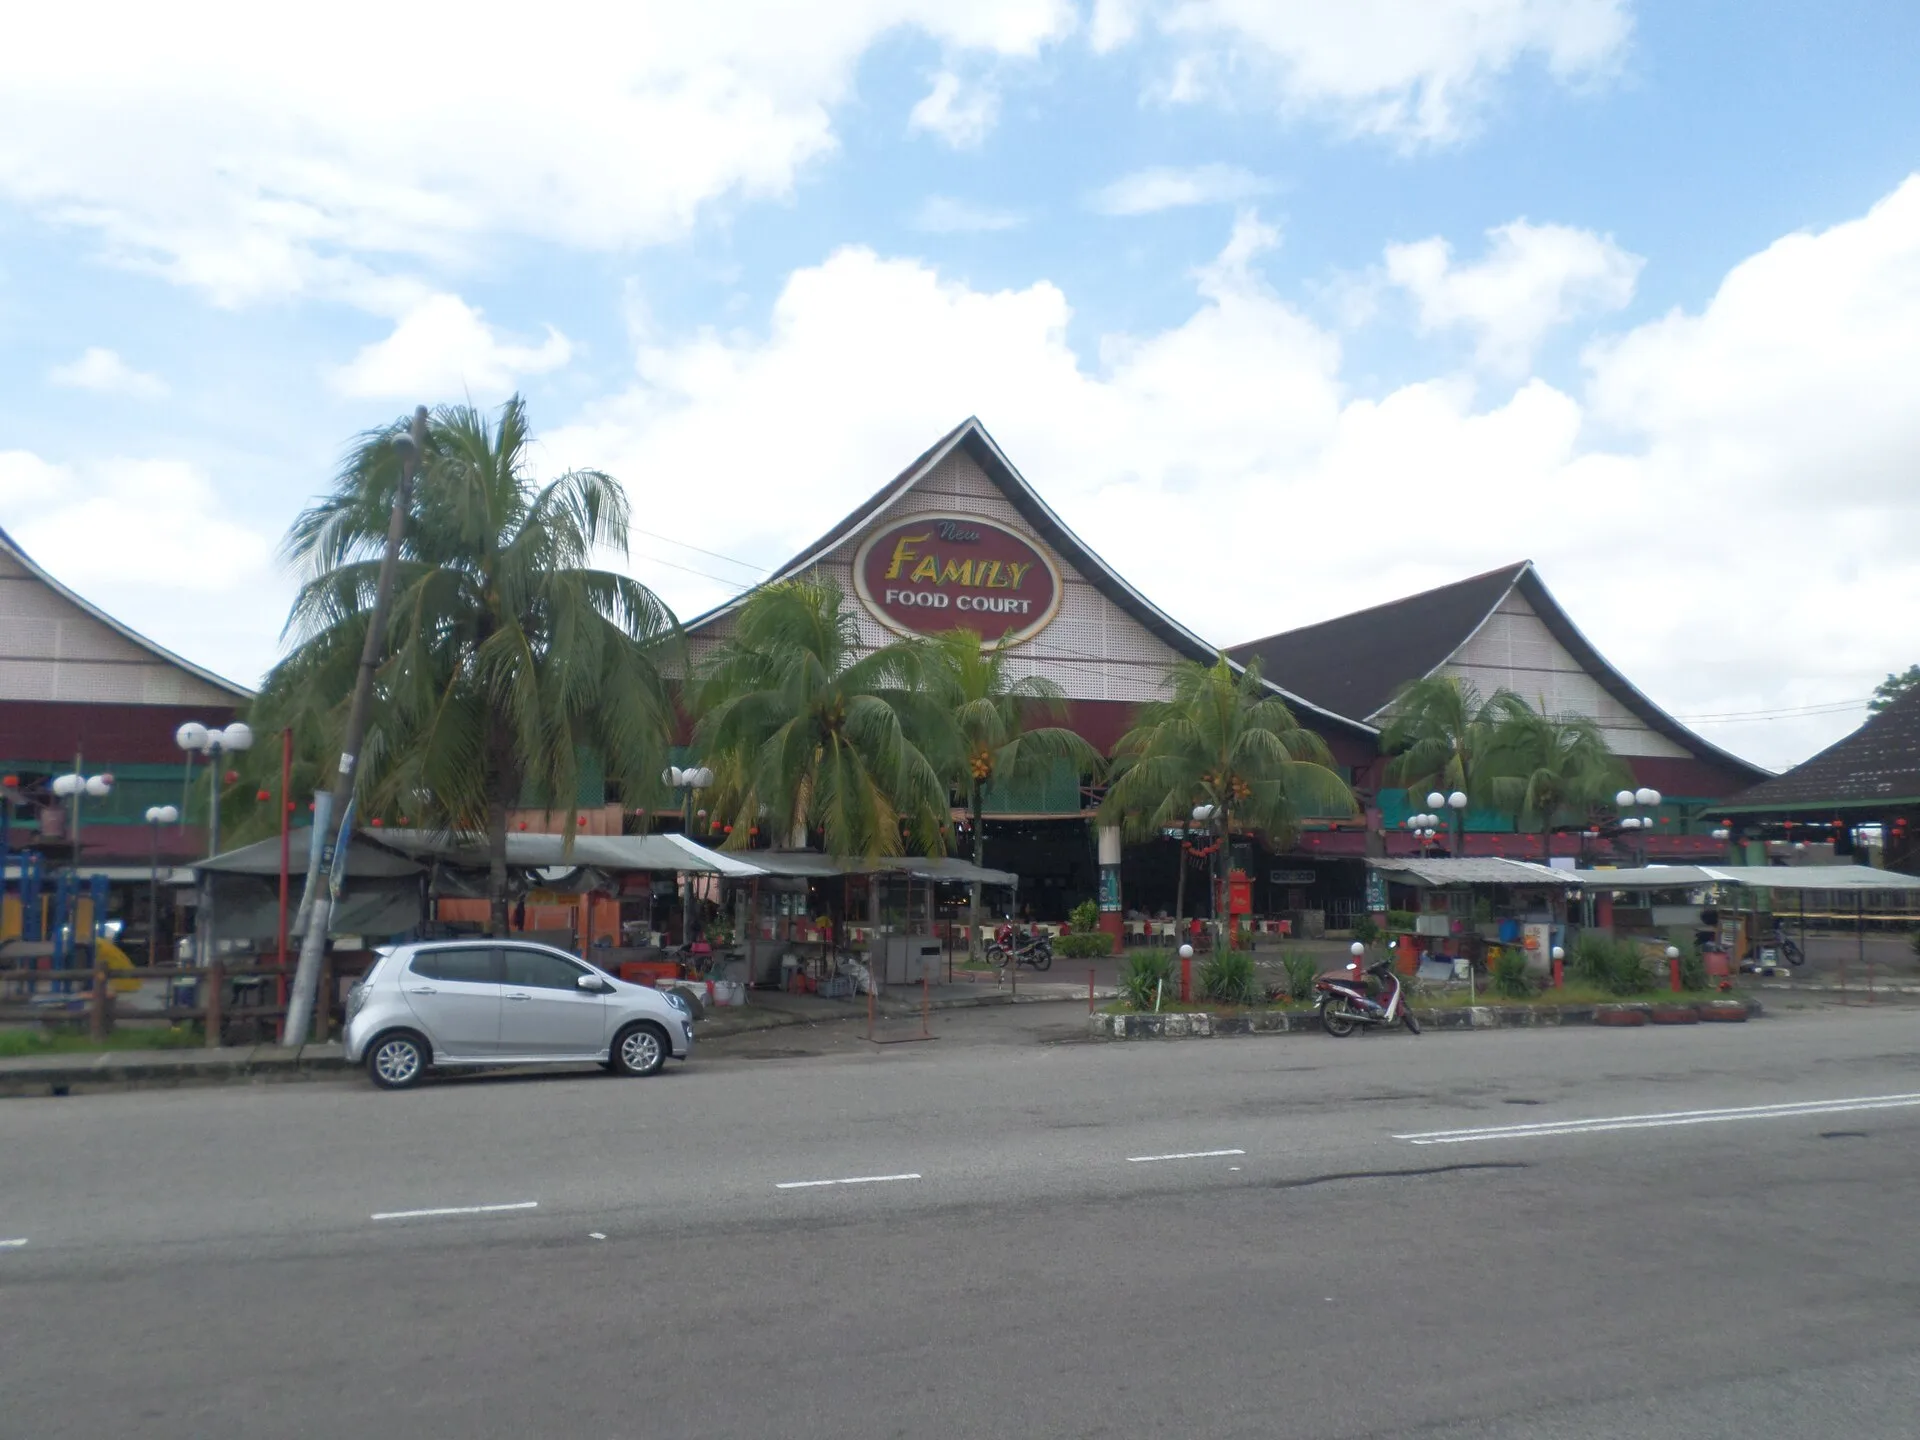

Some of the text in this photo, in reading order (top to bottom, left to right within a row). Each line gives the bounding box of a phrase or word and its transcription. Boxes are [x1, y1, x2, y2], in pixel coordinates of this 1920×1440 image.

[938, 521, 980, 541] New
[884, 531, 1034, 590] FAMILY
[885, 589, 1032, 614] FOOD COURT
